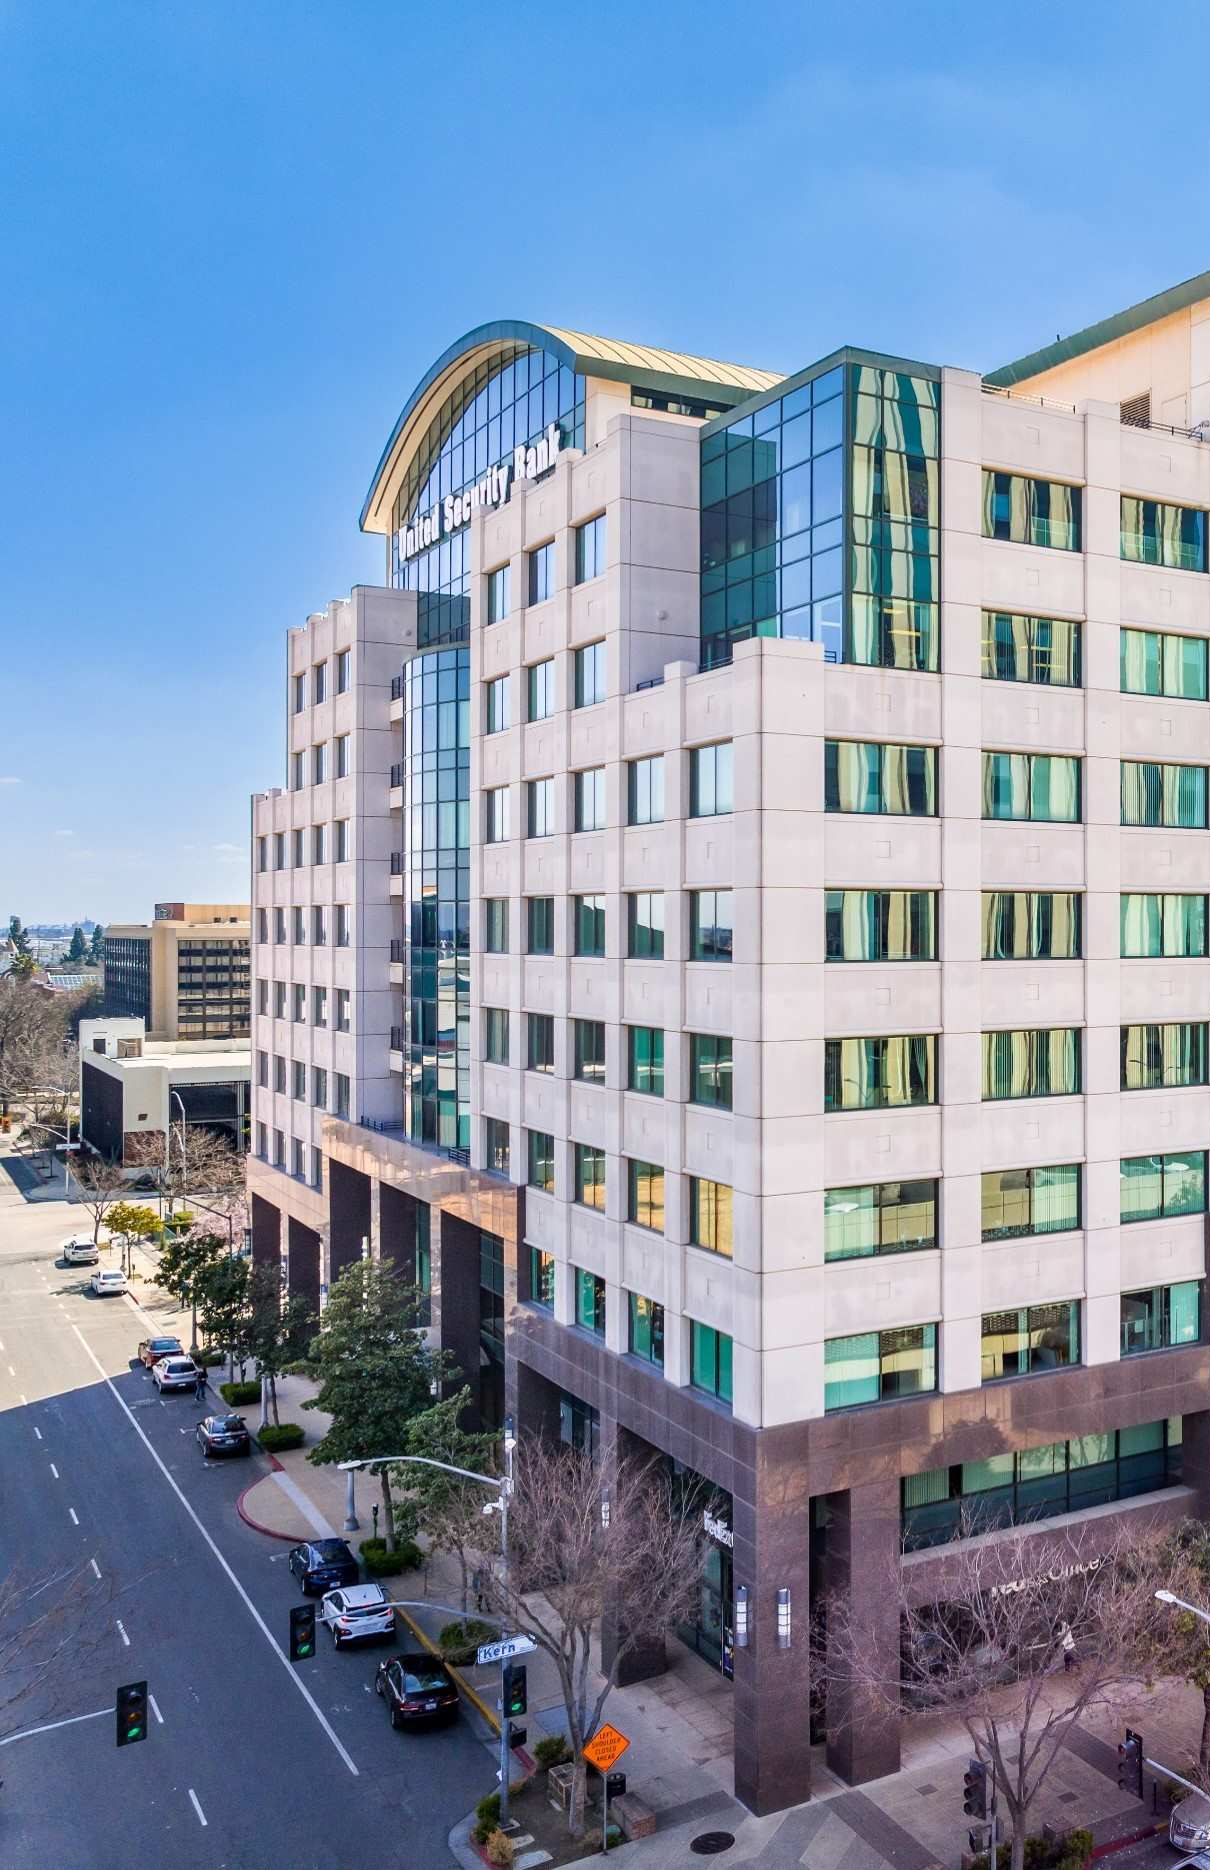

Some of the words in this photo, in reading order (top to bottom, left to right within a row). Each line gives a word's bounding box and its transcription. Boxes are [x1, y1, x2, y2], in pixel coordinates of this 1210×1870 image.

[398, 503, 441, 561] United
[444, 464, 510, 533] Security
[514, 423, 561, 480] Bank
[483, 1644, 516, 1659] Kern
[599, 1731, 613, 1740] LEFT
[592, 1737, 621, 1749] SHOULDER
[595, 1746, 617, 1755] CLOSED
[596, 1753, 615, 1761] AHEAD
